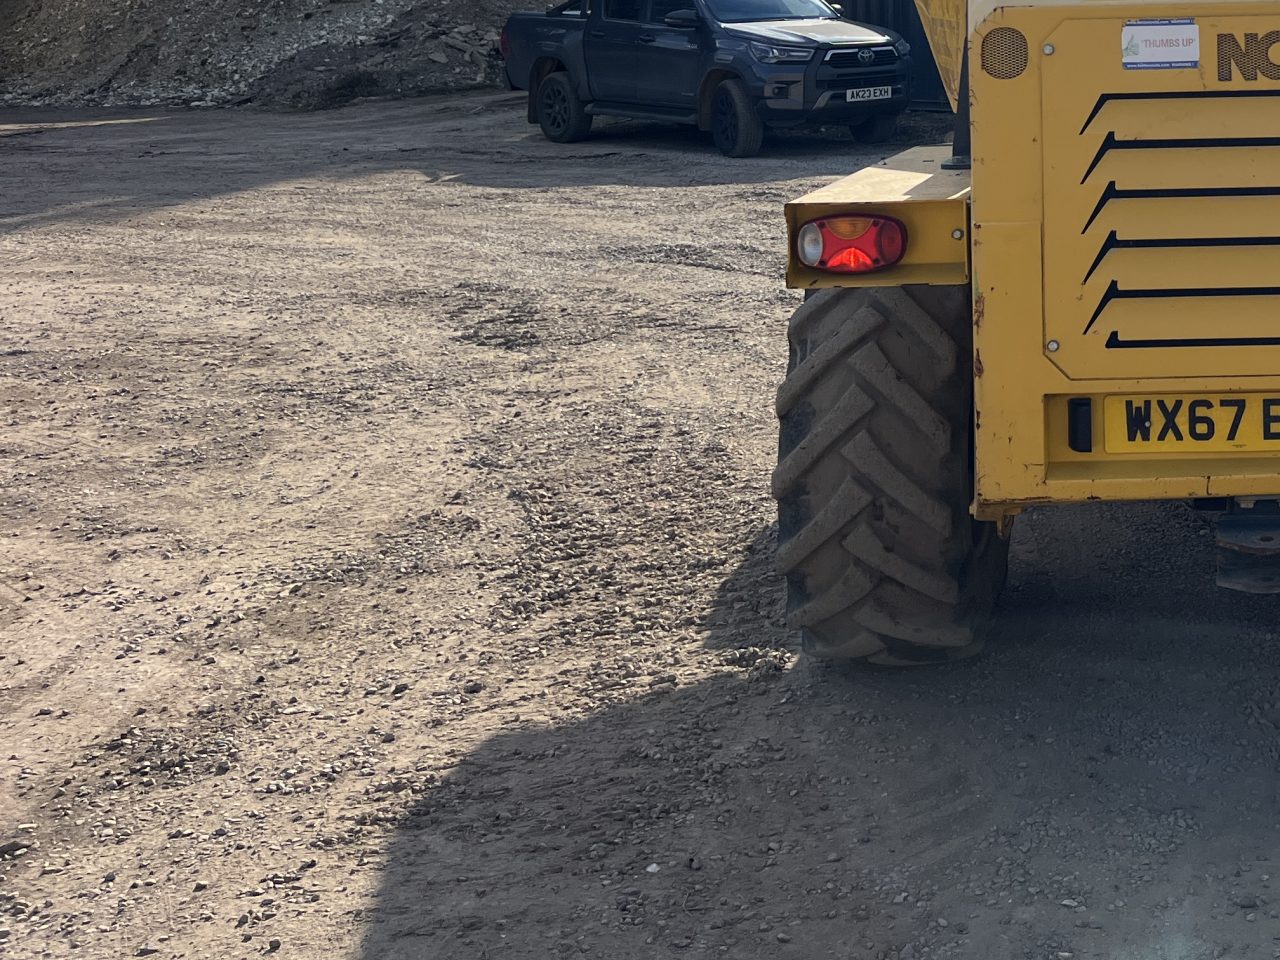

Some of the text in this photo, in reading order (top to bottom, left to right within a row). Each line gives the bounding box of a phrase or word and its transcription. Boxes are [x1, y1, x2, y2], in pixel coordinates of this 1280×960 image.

[850, 87, 889, 100] AK23 EXH
[1125, 398, 1246, 442] WX67
